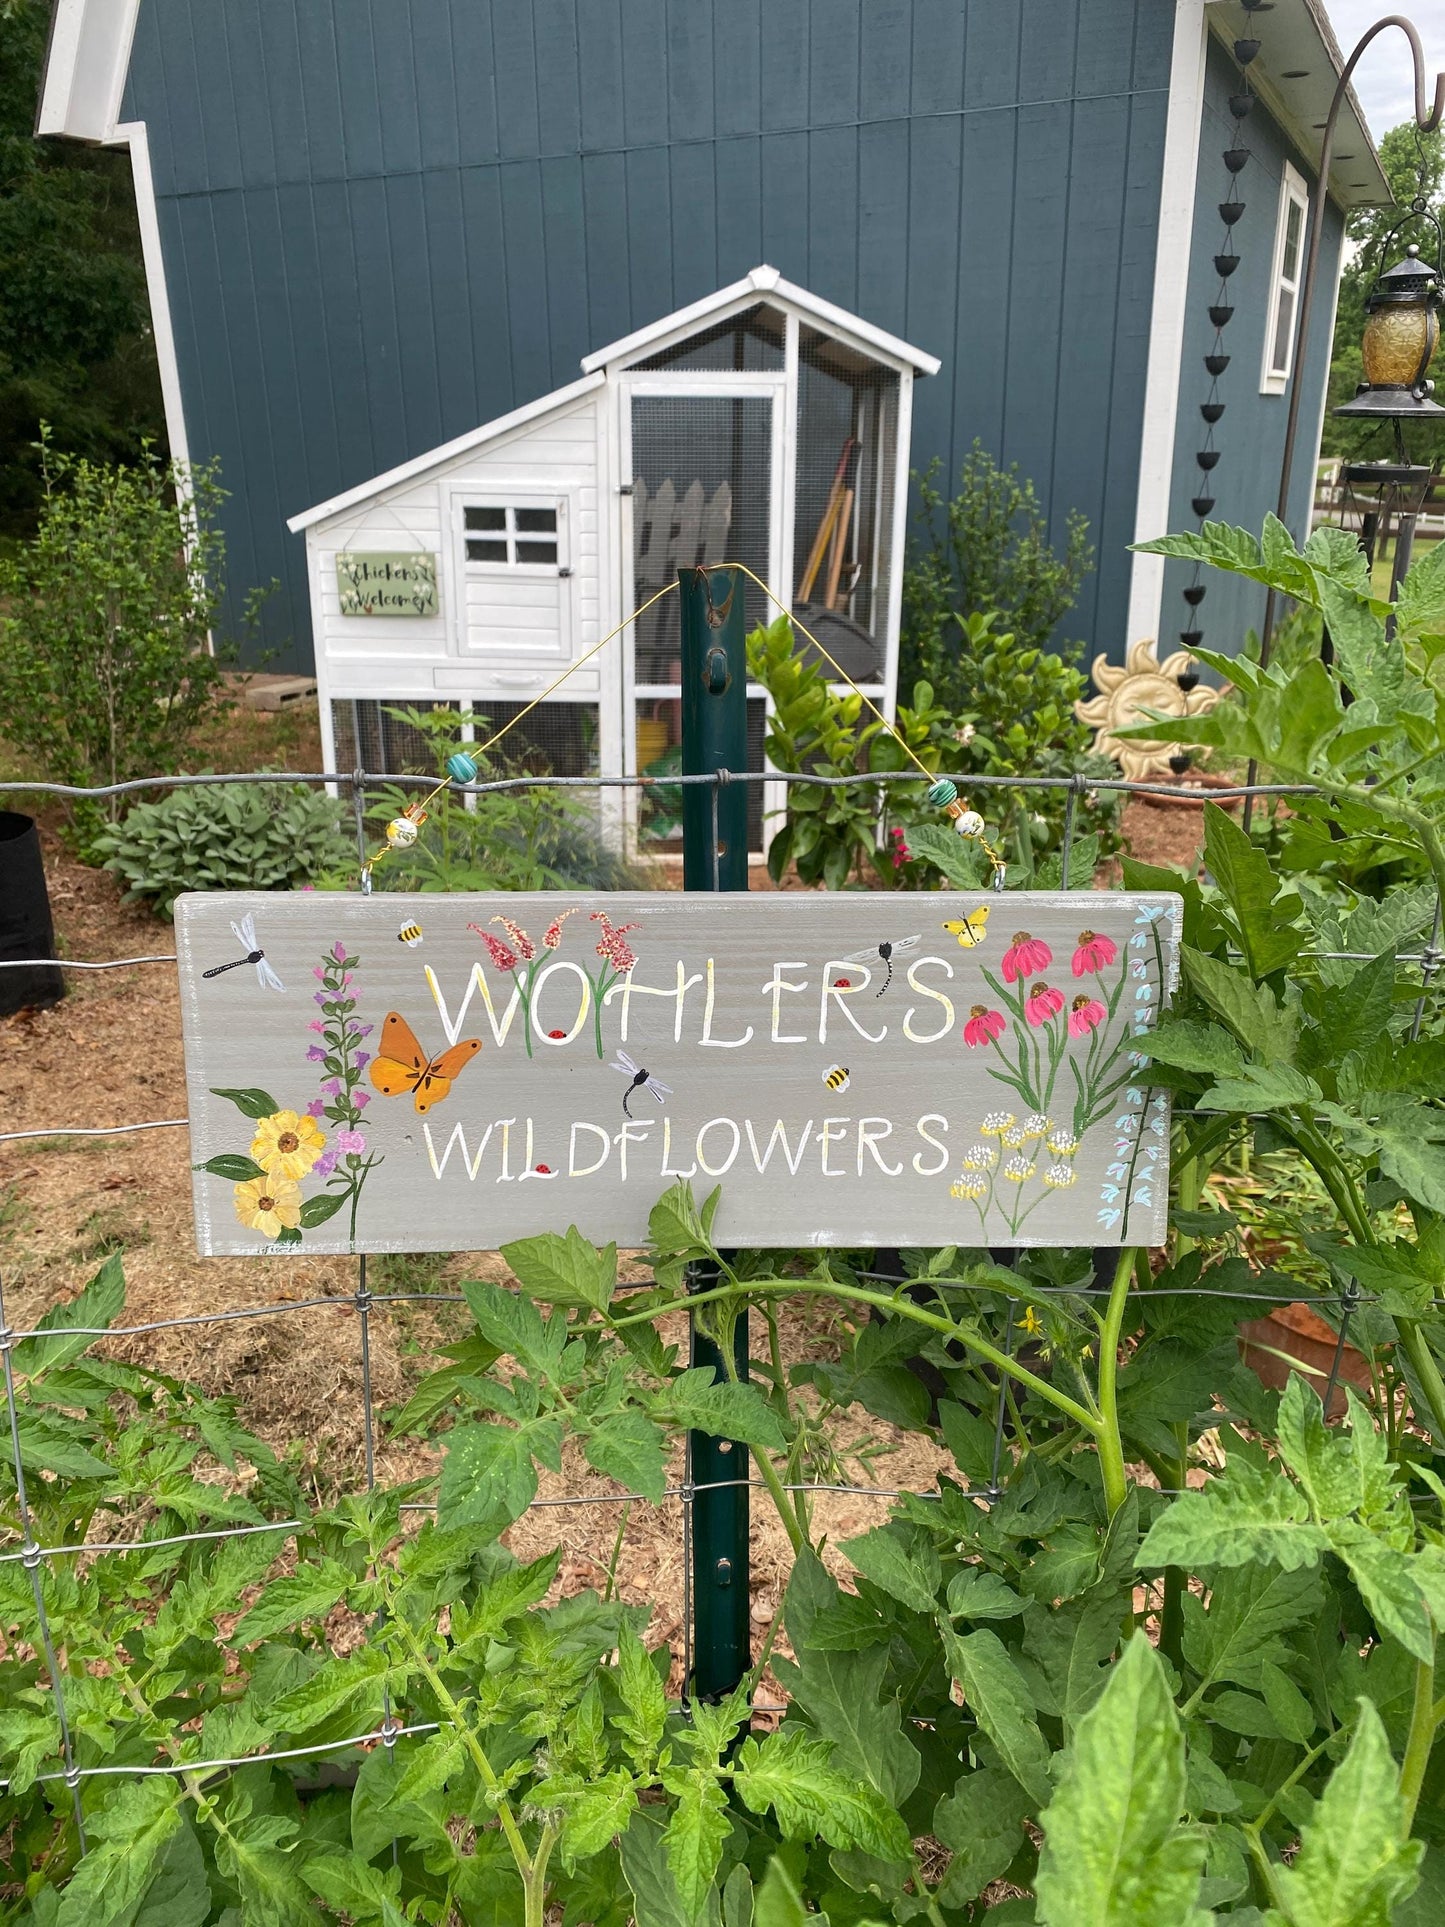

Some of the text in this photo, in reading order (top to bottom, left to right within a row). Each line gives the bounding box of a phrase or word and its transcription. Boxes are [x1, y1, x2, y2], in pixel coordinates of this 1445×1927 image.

[355, 562, 418, 581] Chickens
[356, 590, 420, 607] Welcome
[423, 1114, 949, 1182] WILDFLOWERS
